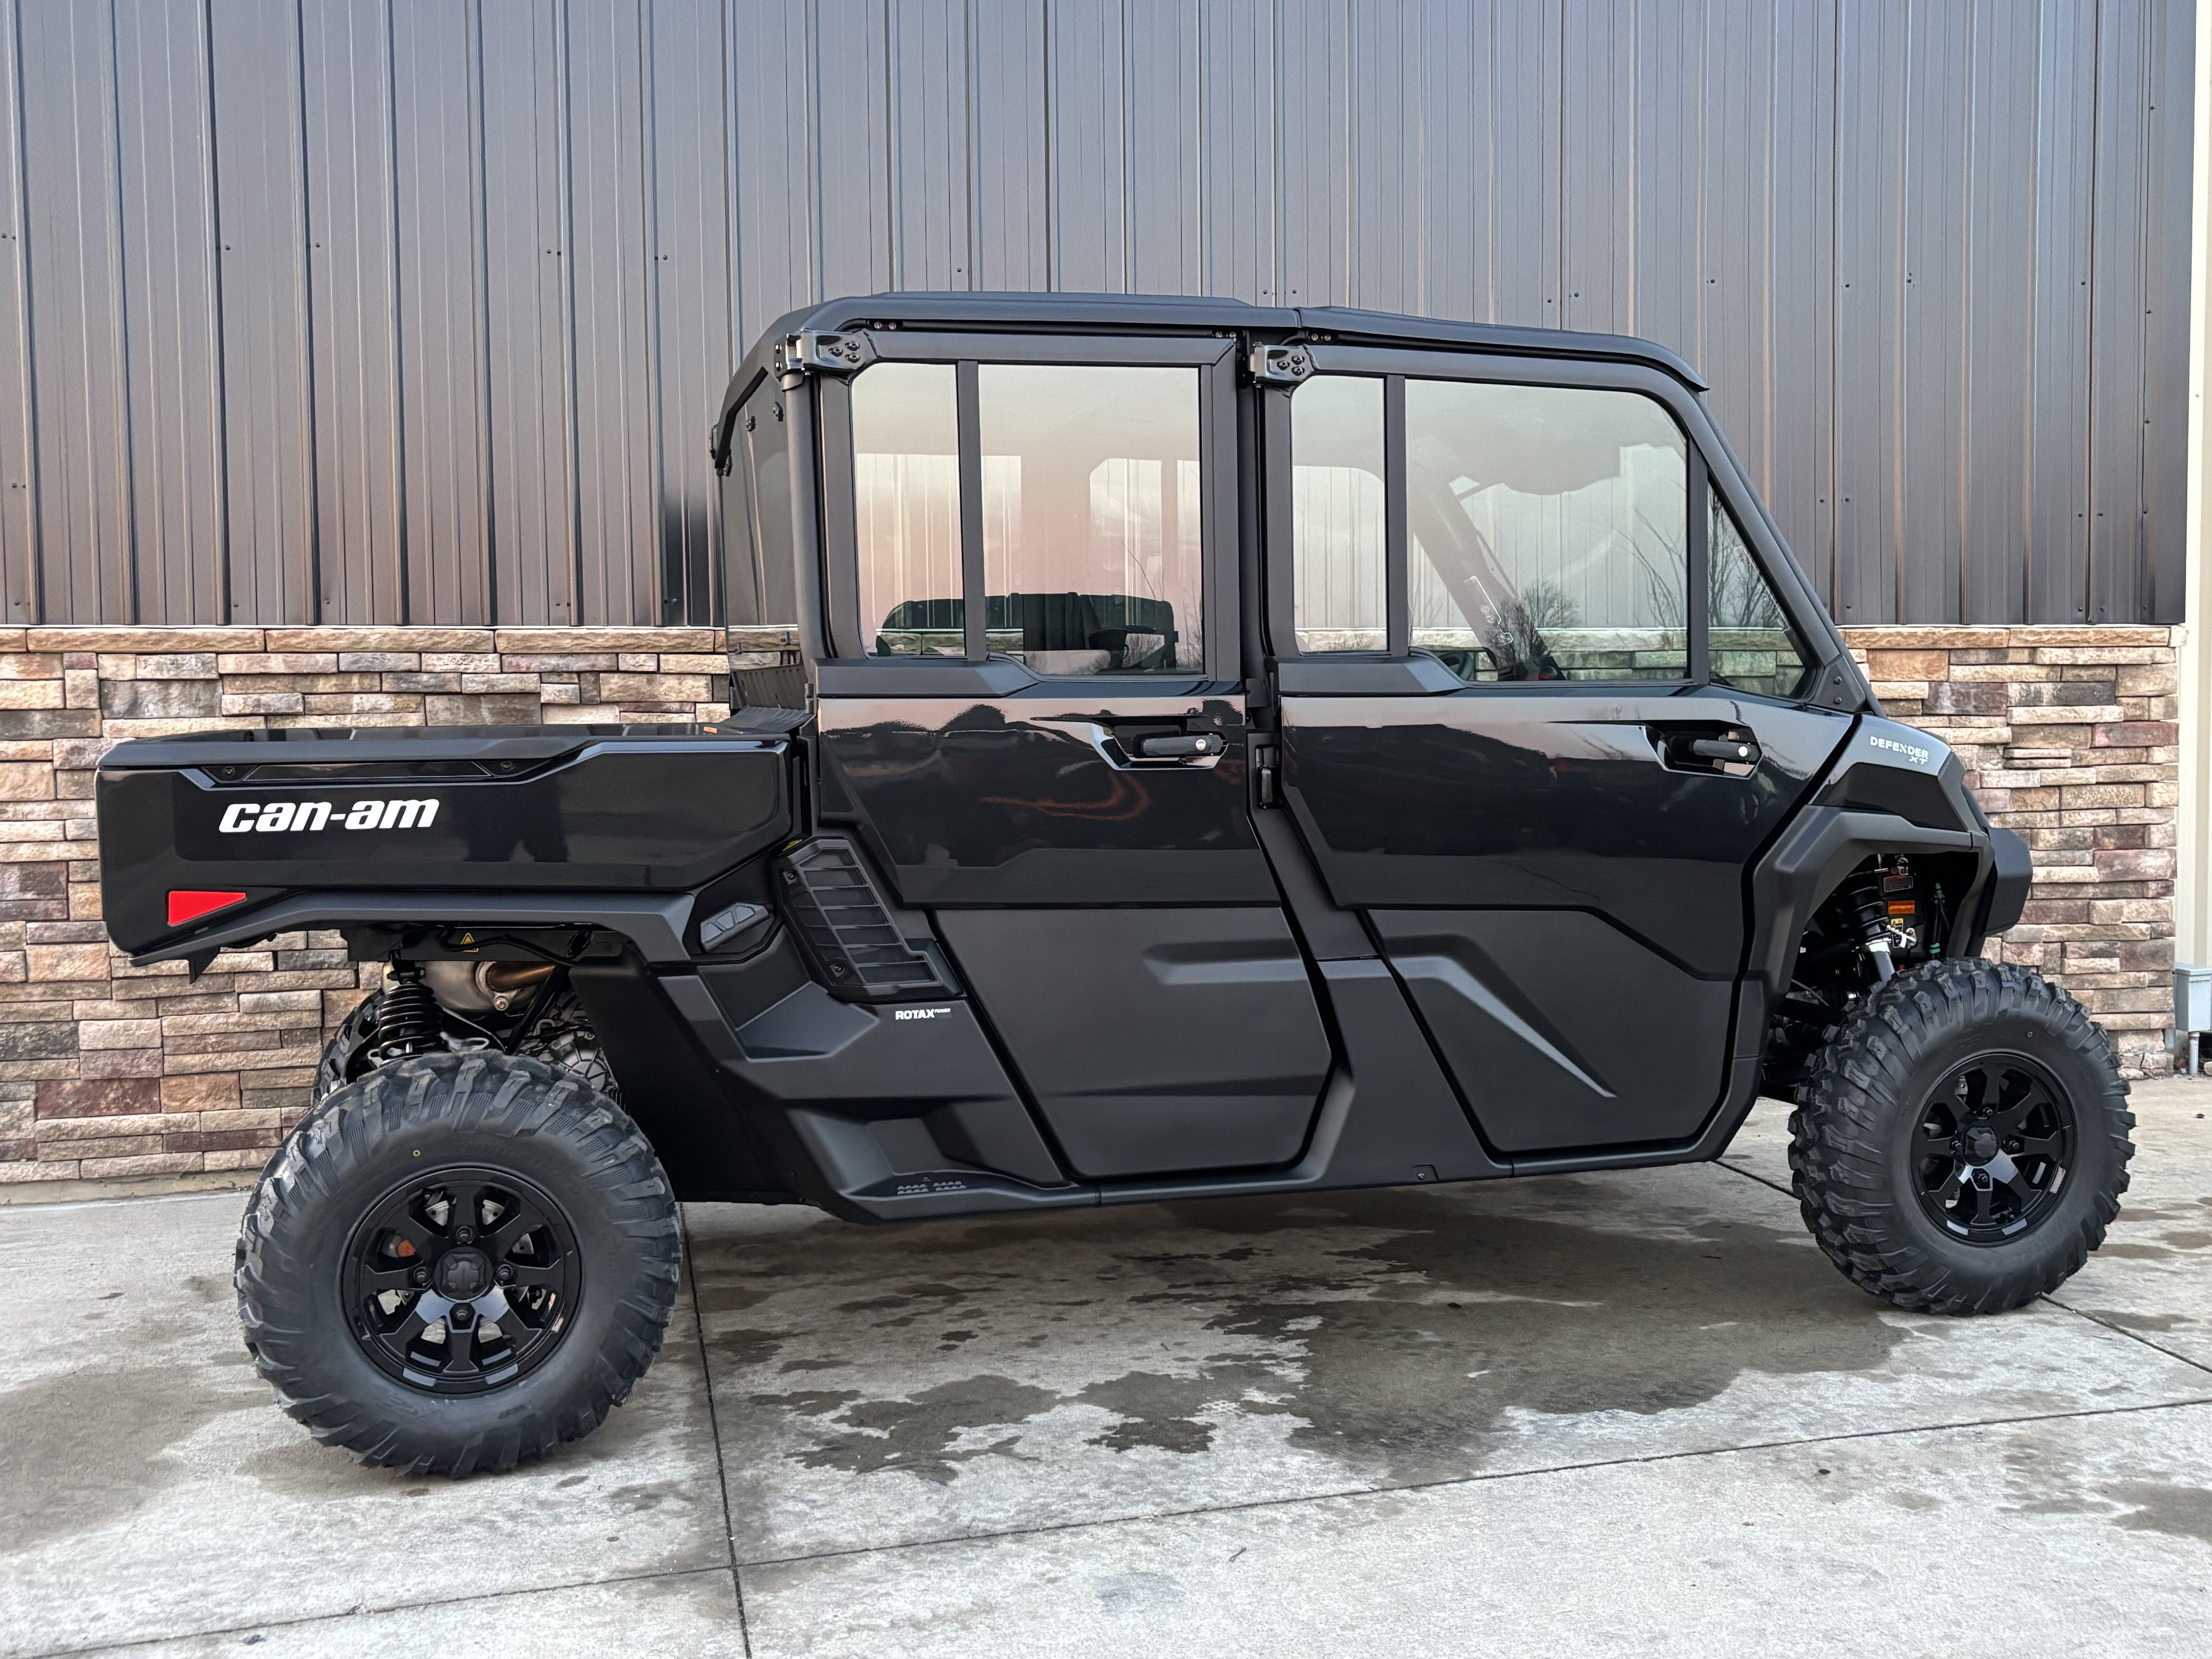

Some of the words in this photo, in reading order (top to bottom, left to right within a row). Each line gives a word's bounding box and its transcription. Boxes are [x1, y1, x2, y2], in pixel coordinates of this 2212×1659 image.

[1870, 736, 1929, 759] DEFENDER
[1908, 756, 1928, 765] XT
[218, 799, 440, 833] can-am
[895, 1008, 935, 1020] ROTAX
